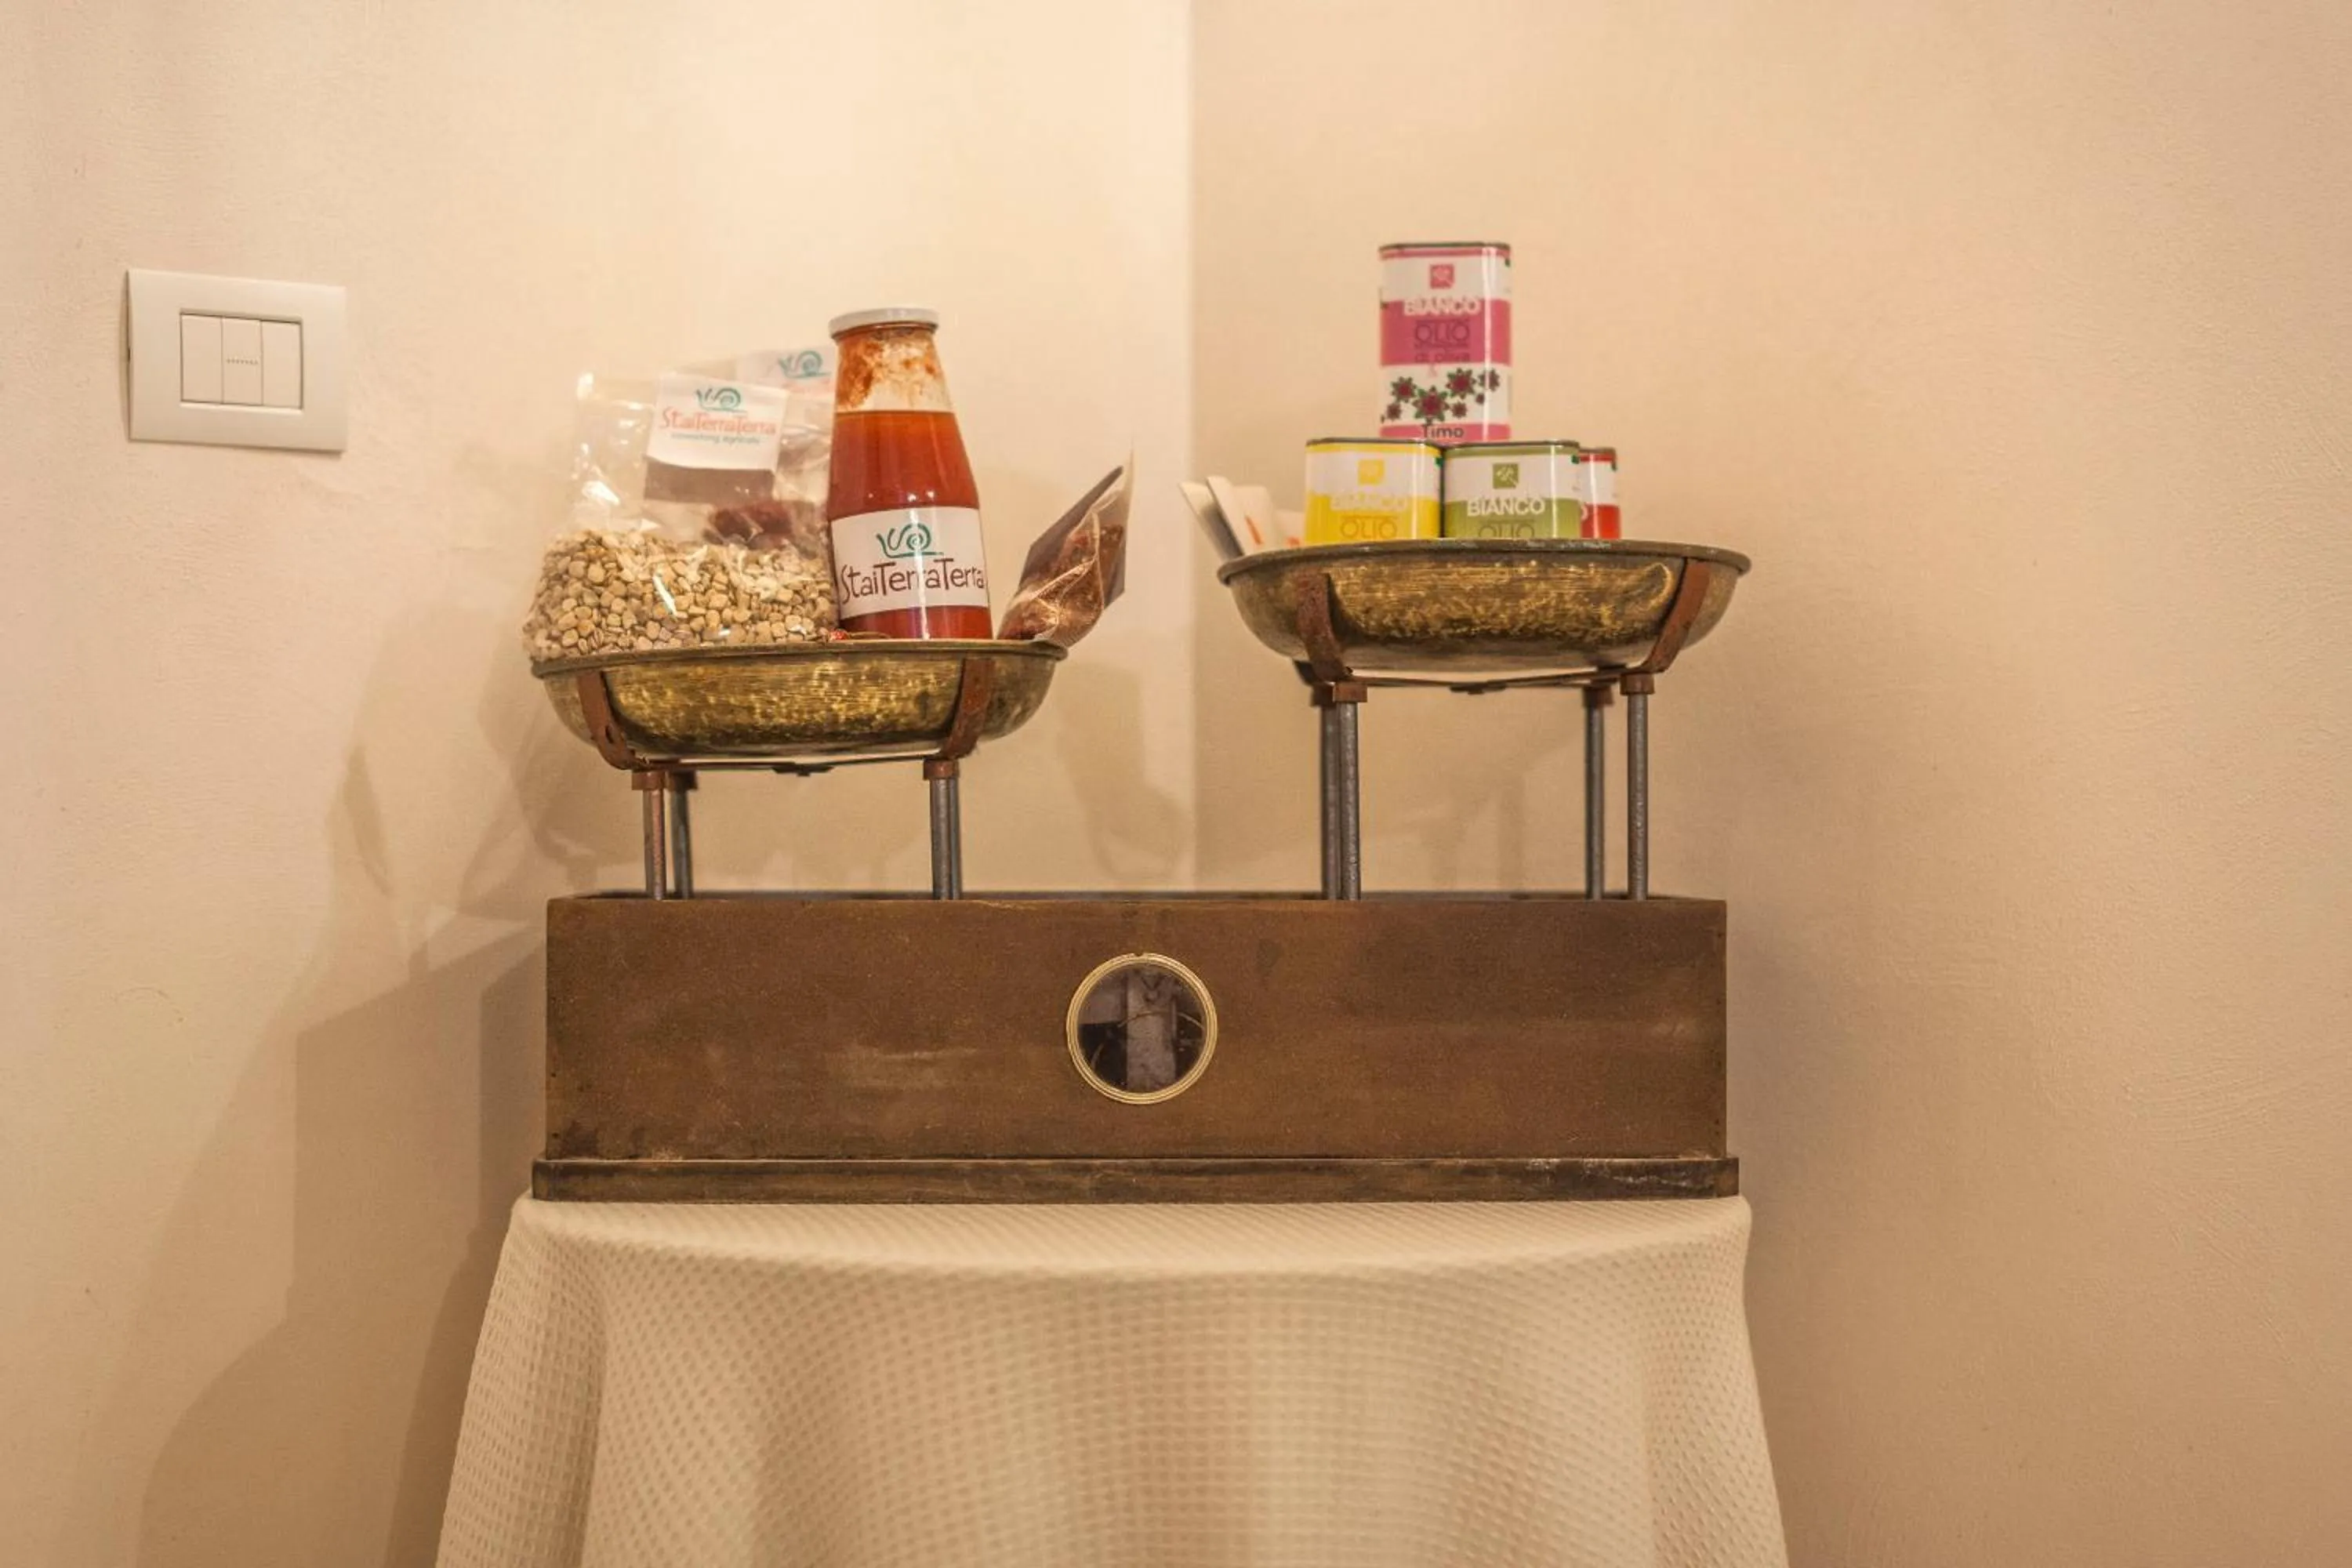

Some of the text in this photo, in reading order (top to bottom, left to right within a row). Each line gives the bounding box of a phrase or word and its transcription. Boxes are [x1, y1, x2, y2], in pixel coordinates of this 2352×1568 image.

[1403, 297, 1481, 316] BIANCO
[1414, 319, 1470, 345] OLIO
[1421, 424, 1464, 438] Timo
[1467, 497, 1545, 517] BIANCO
[1340, 517, 1398, 539] OLIO
[840, 557, 985, 605] StaiTerraTerra
